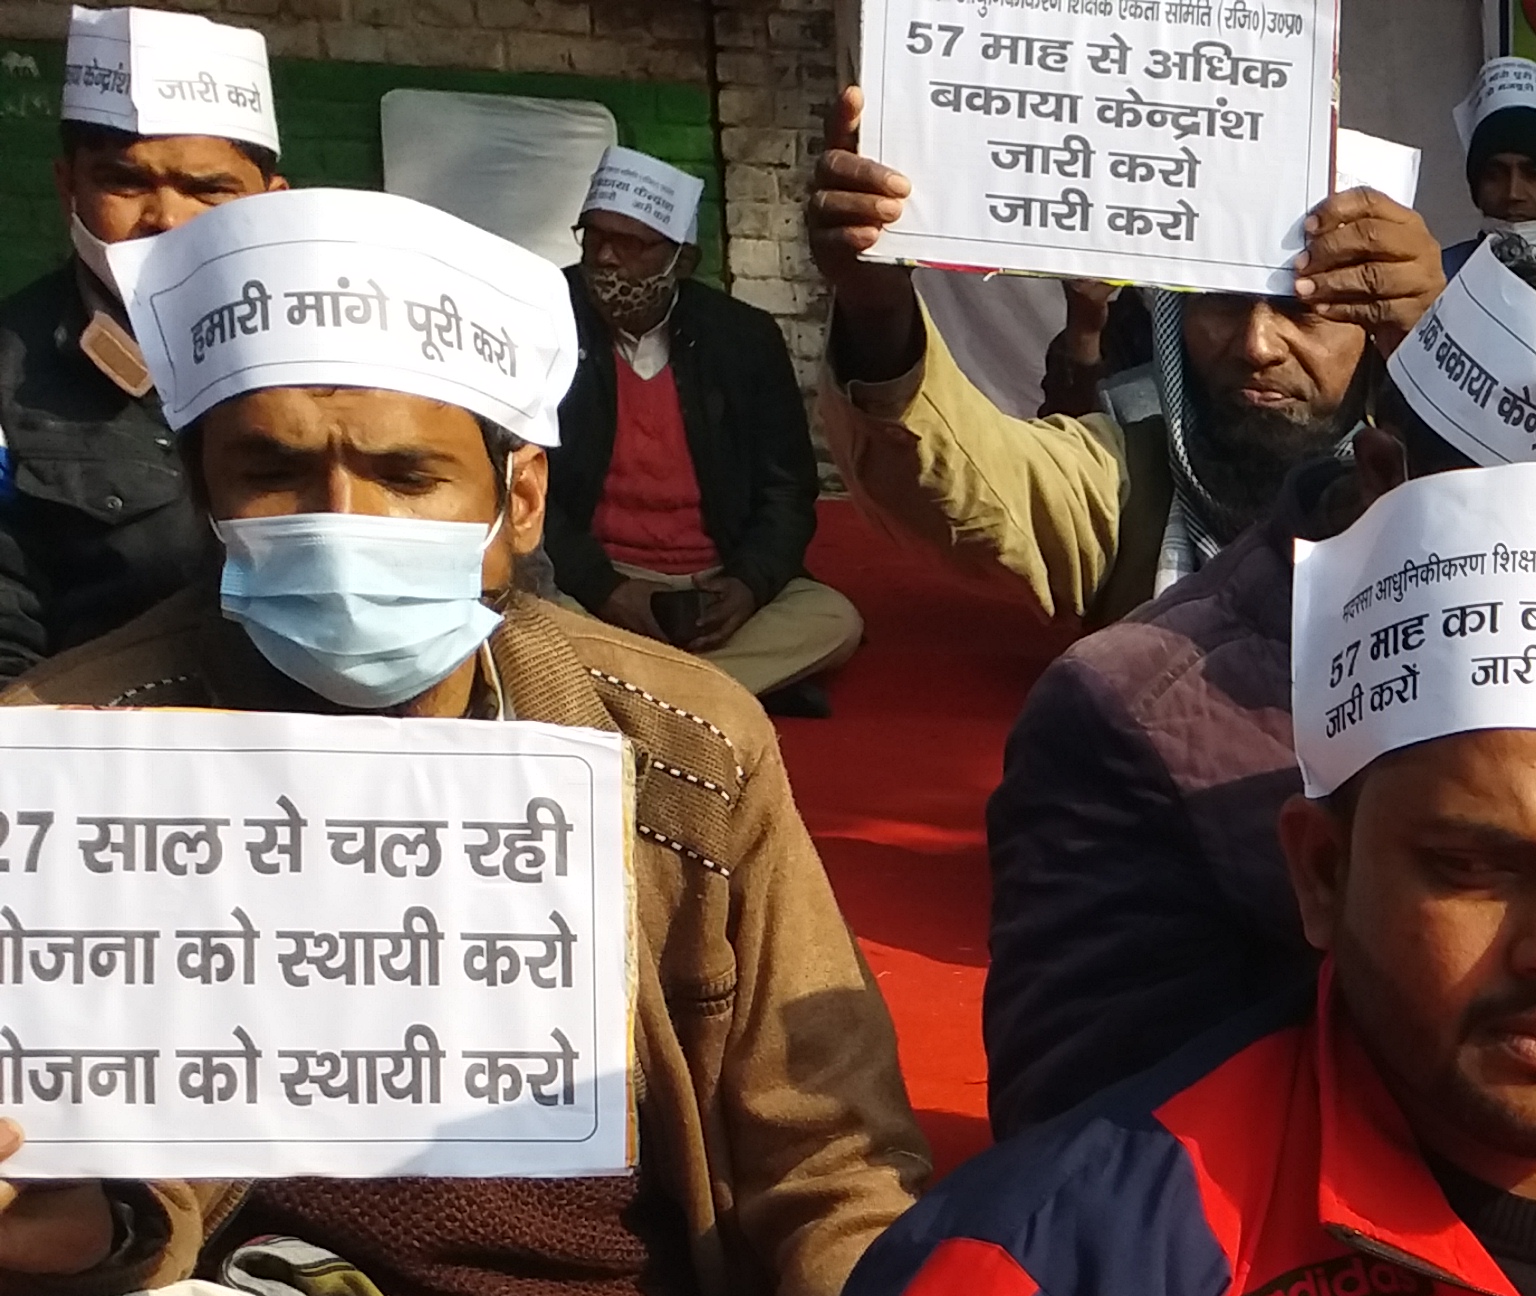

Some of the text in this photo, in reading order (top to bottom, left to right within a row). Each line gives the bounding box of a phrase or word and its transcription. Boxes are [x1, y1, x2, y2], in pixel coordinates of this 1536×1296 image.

[155, 72, 262, 113] जारी करो
[905, 20, 1293, 90] 57 माह से अधिक
[929, 80, 1264, 141] बकाया केन्द्रांश
[987, 134, 1201, 188] जारी करो
[985, 187, 1199, 241] जारी करो
[190, 277, 519, 377] हमारी मांगे पूरी करो
[1436, 334, 1498, 409] बकाया
[1329, 640, 1361, 689] 57
[1370, 612, 1430, 661] माह
[1442, 601, 1503, 639] का
[1325, 685, 1364, 740] जारी
[1370, 664, 1420, 713] करों
[77, 795, 572, 883] साल से चल रही
[176, 906, 577, 989] को स्थायी करो
[176, 1025, 579, 1107] को स्थायी करो
